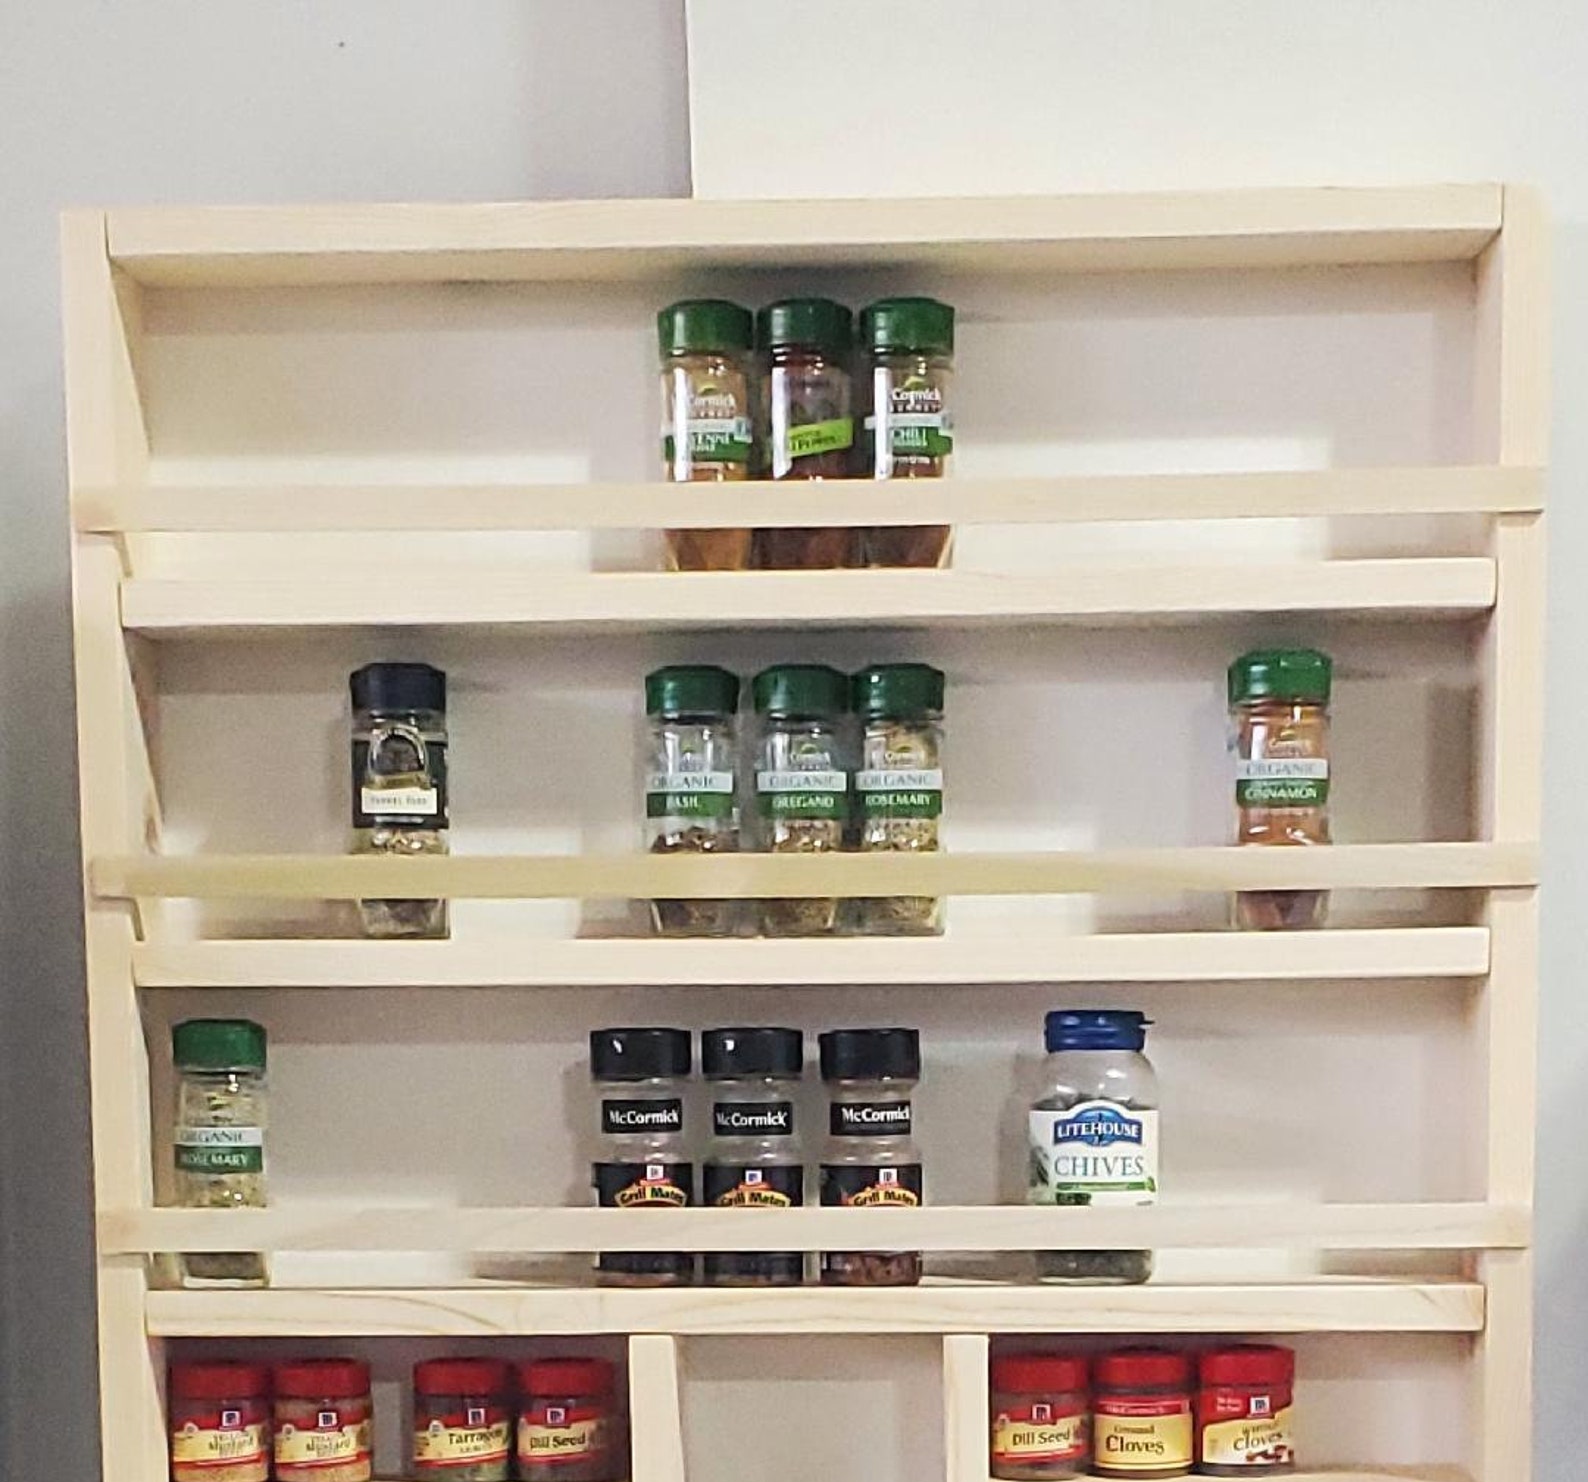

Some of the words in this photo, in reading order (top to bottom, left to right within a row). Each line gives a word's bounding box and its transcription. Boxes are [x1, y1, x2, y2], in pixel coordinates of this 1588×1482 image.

[768, 775, 834, 789] ORGANIC
[862, 773, 929, 788] ORGANIC
[772, 795, 835, 808] OREGANO
[865, 792, 931, 806] ROSEMARY
[609, 1108, 679, 1125] McCormick
[716, 1111, 788, 1127] McCormick
[1057, 1121, 1139, 1138] LITEHOUSE
[1054, 1155, 1144, 1177] CHIVES
[529, 1435, 550, 1450] Dill
[551, 1432, 586, 1449] Seed
[1012, 1431, 1035, 1447] Dill
[1037, 1428, 1071, 1445] Seed
[1105, 1434, 1165, 1456] Cloves
